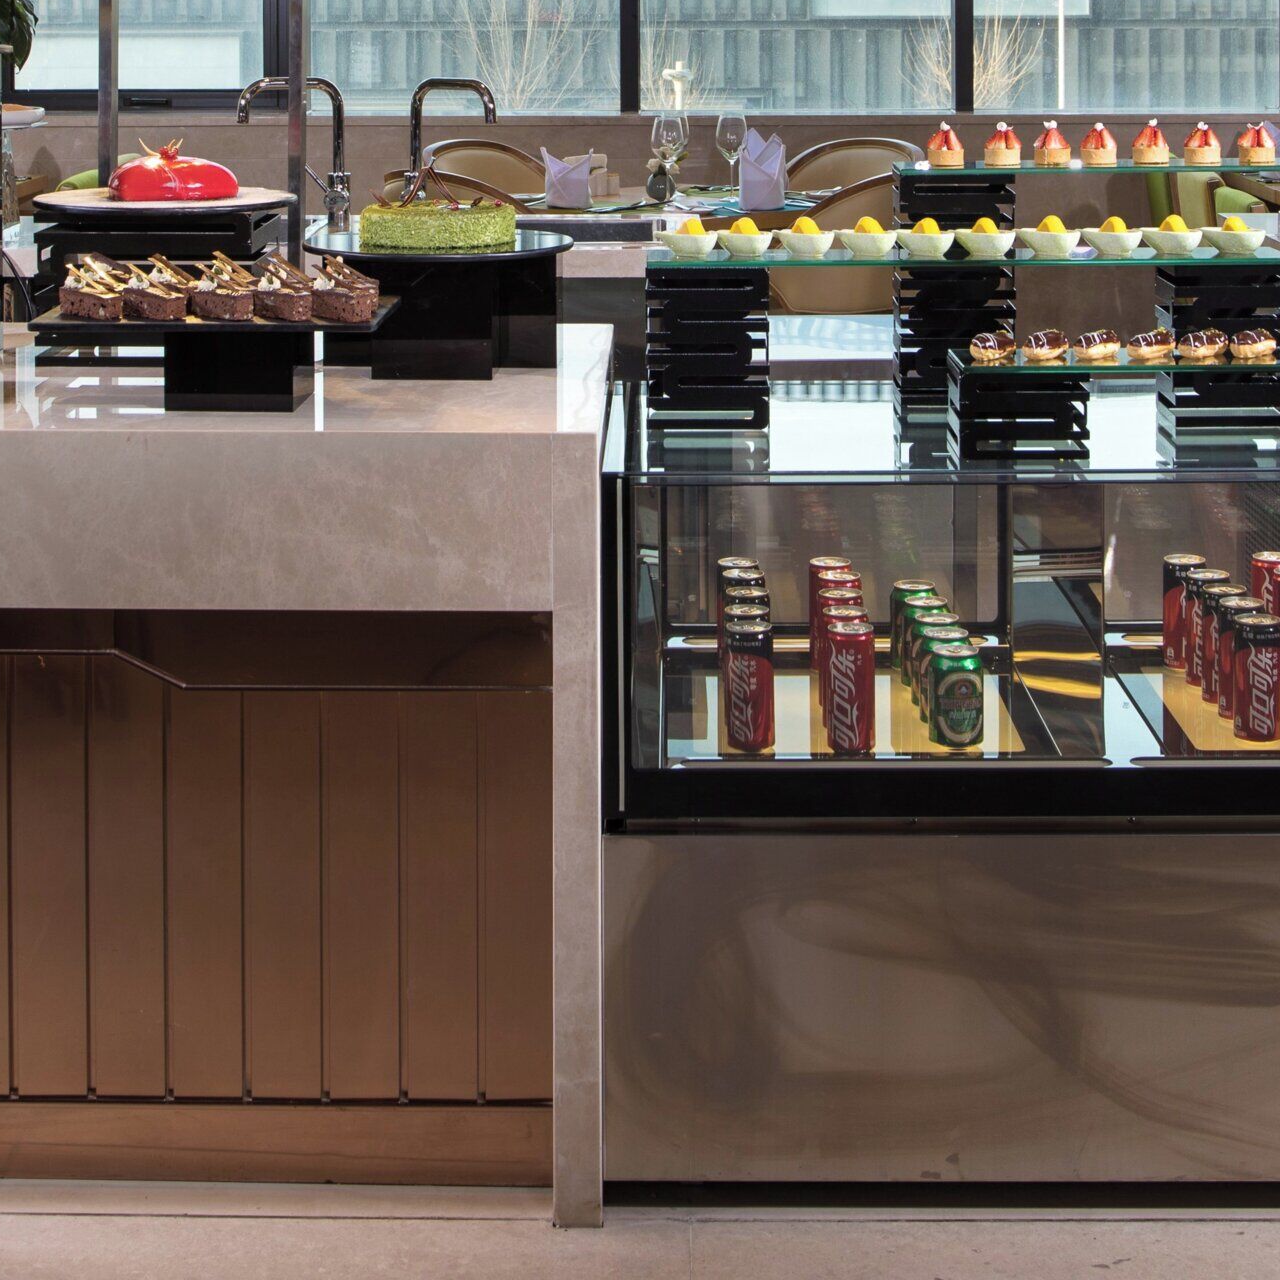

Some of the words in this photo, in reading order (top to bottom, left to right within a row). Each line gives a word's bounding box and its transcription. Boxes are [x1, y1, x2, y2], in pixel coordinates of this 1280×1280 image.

[729, 649, 754, 742] 可口可乐
[829, 639, 859, 749] 可口可乐
[1247, 641, 1275, 736] 可口可乐
